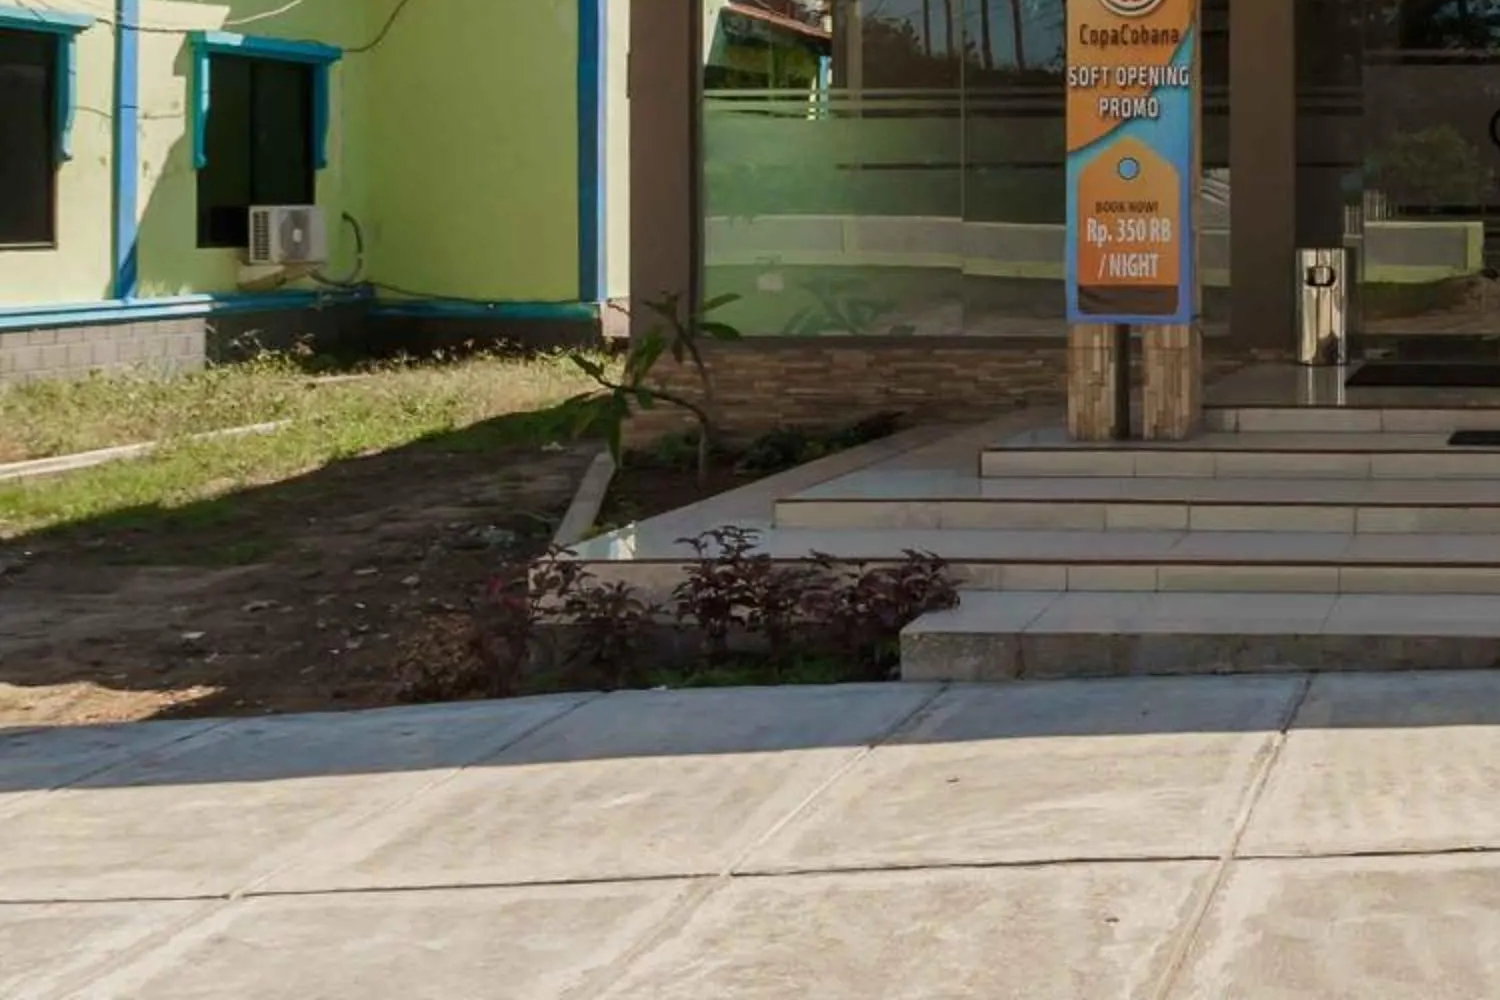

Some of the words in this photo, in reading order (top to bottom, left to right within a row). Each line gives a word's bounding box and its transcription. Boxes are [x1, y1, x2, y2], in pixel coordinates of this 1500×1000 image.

[1080, 24, 1180, 48] CopaCobana
[1068, 65, 1110, 88] SOFT
[1115, 65, 1189, 88] OPENING
[1099, 97, 1159, 118] PROMO
[1087, 217, 1112, 248] Rp.
[1116, 218, 1146, 243] 350
[1150, 217, 1172, 243] RB
